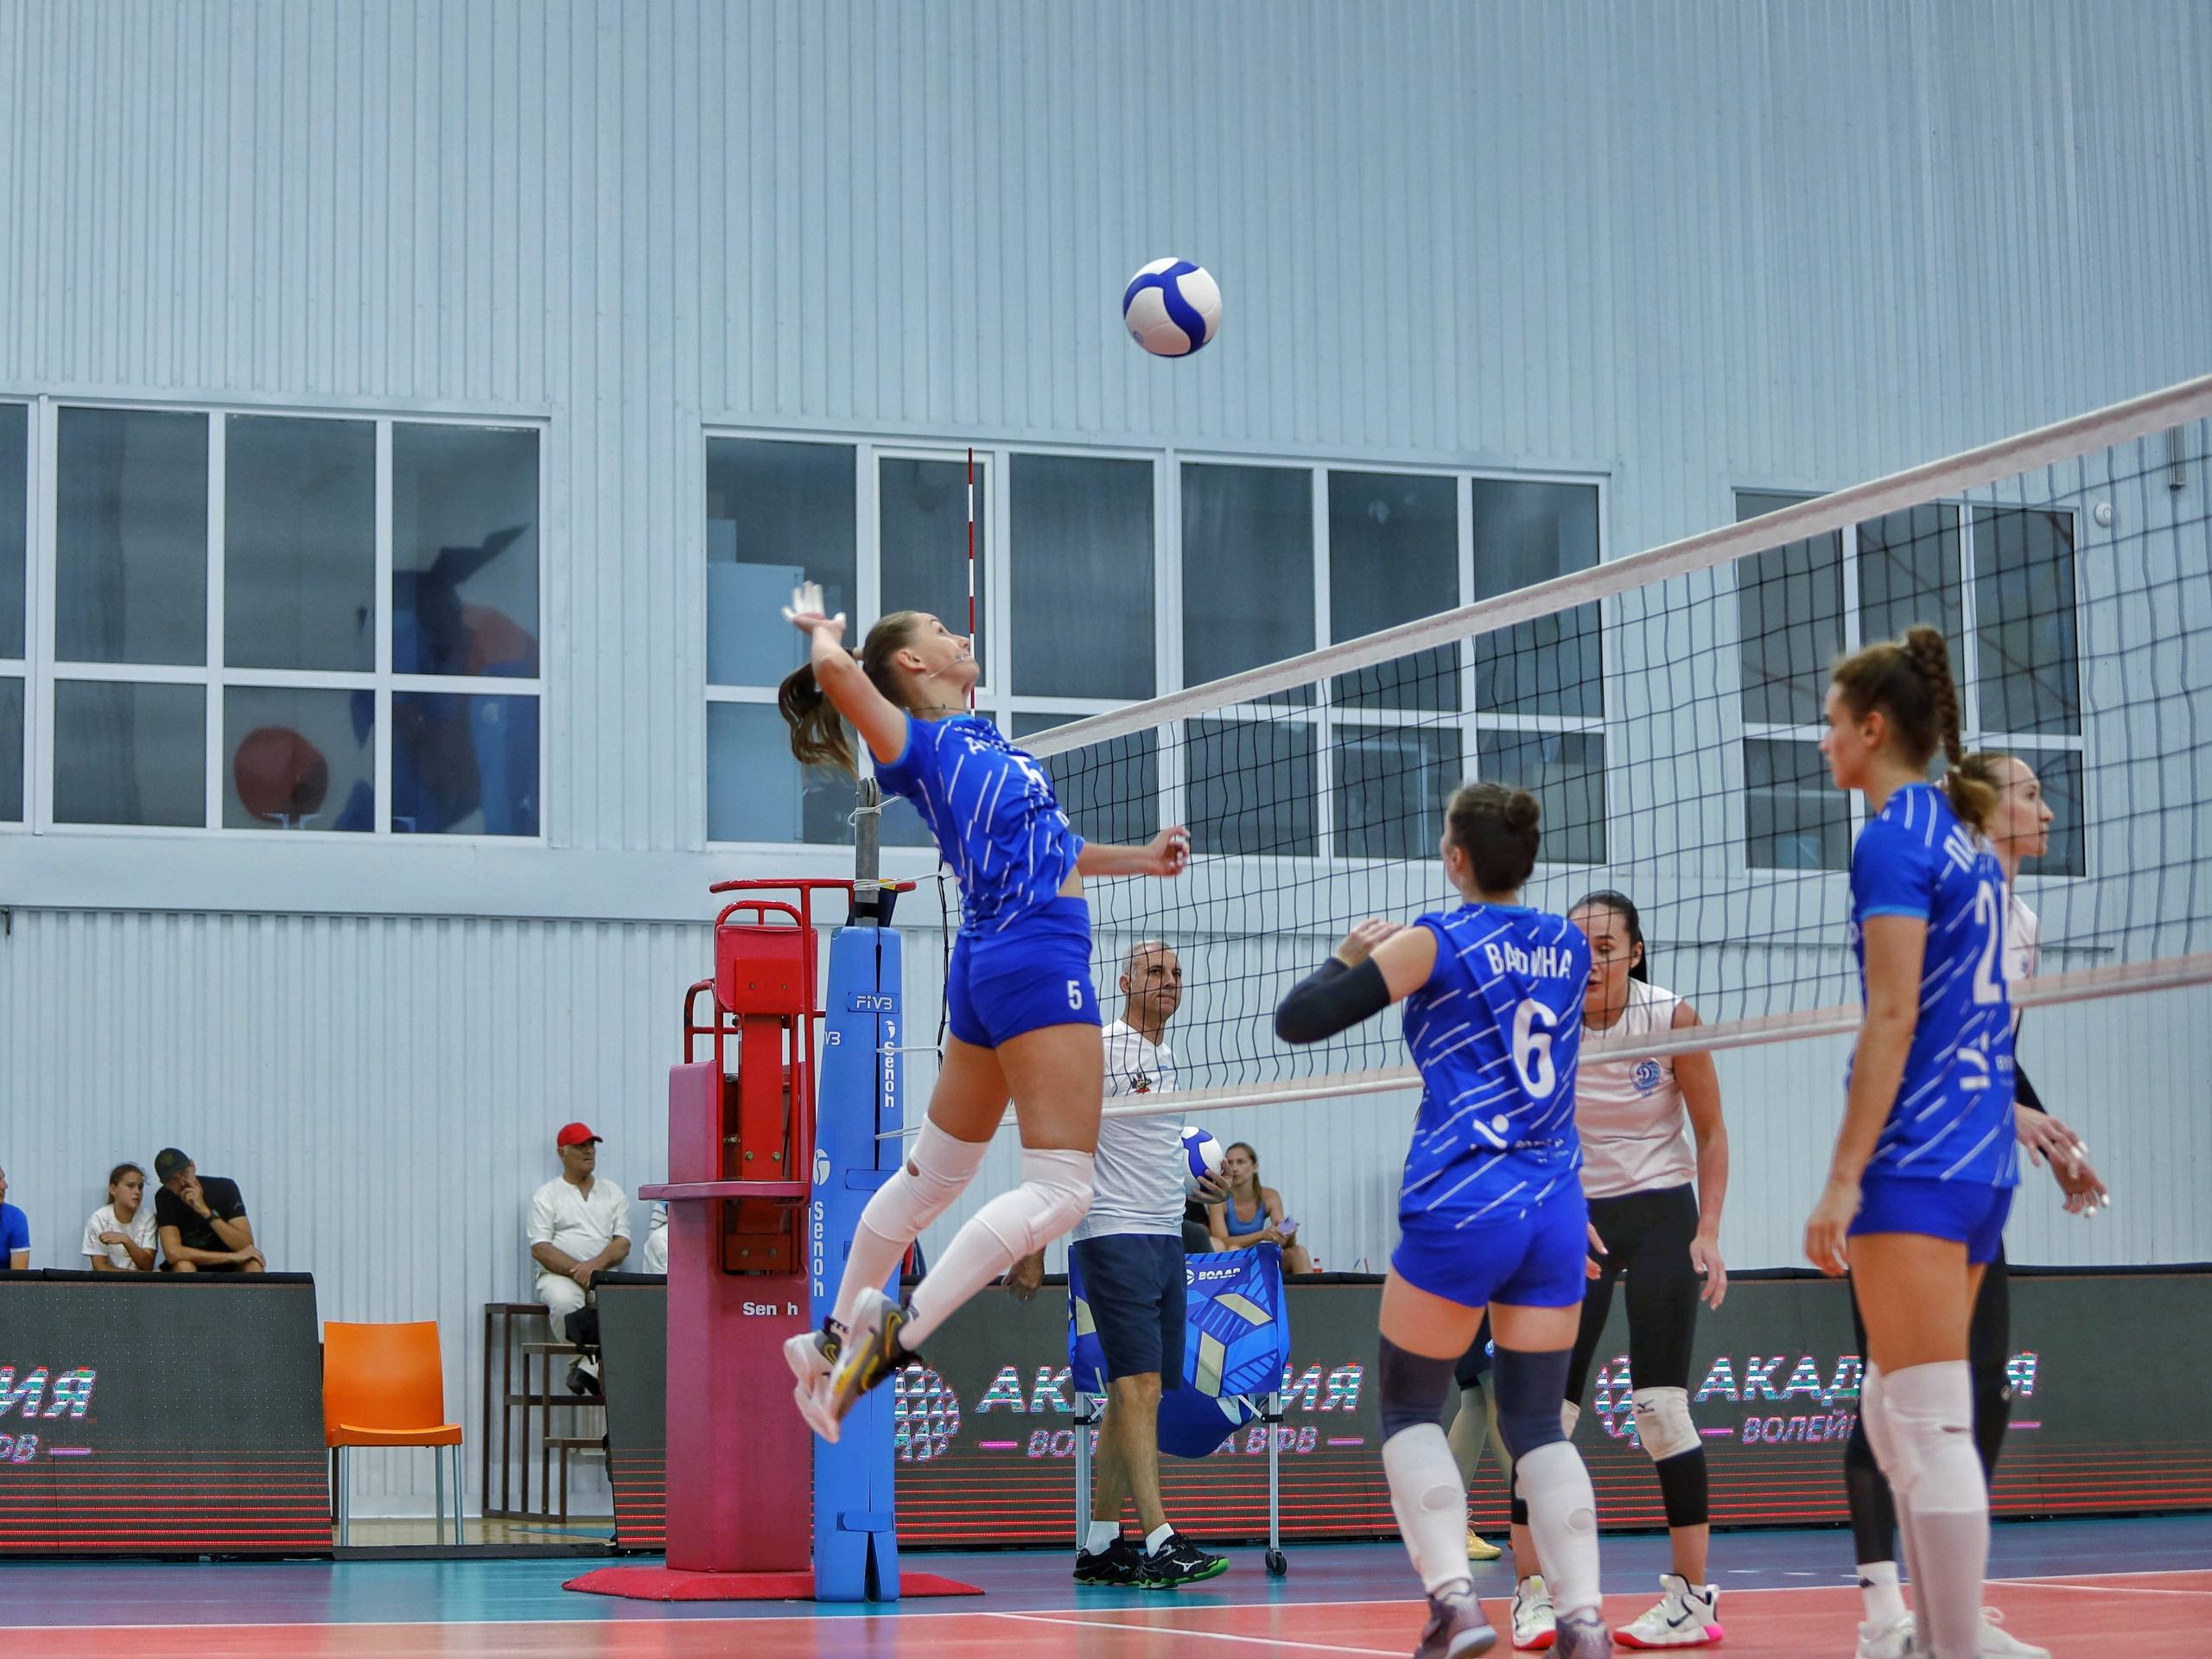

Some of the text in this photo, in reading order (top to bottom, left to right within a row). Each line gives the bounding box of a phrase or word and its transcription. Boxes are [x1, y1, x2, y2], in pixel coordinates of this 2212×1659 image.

[1066, 979, 1083, 1010] 5
[1511, 997, 1559, 1100] 6
[813, 1200, 824, 1297] Senoh
[742, 1301, 798, 1316] Senh
